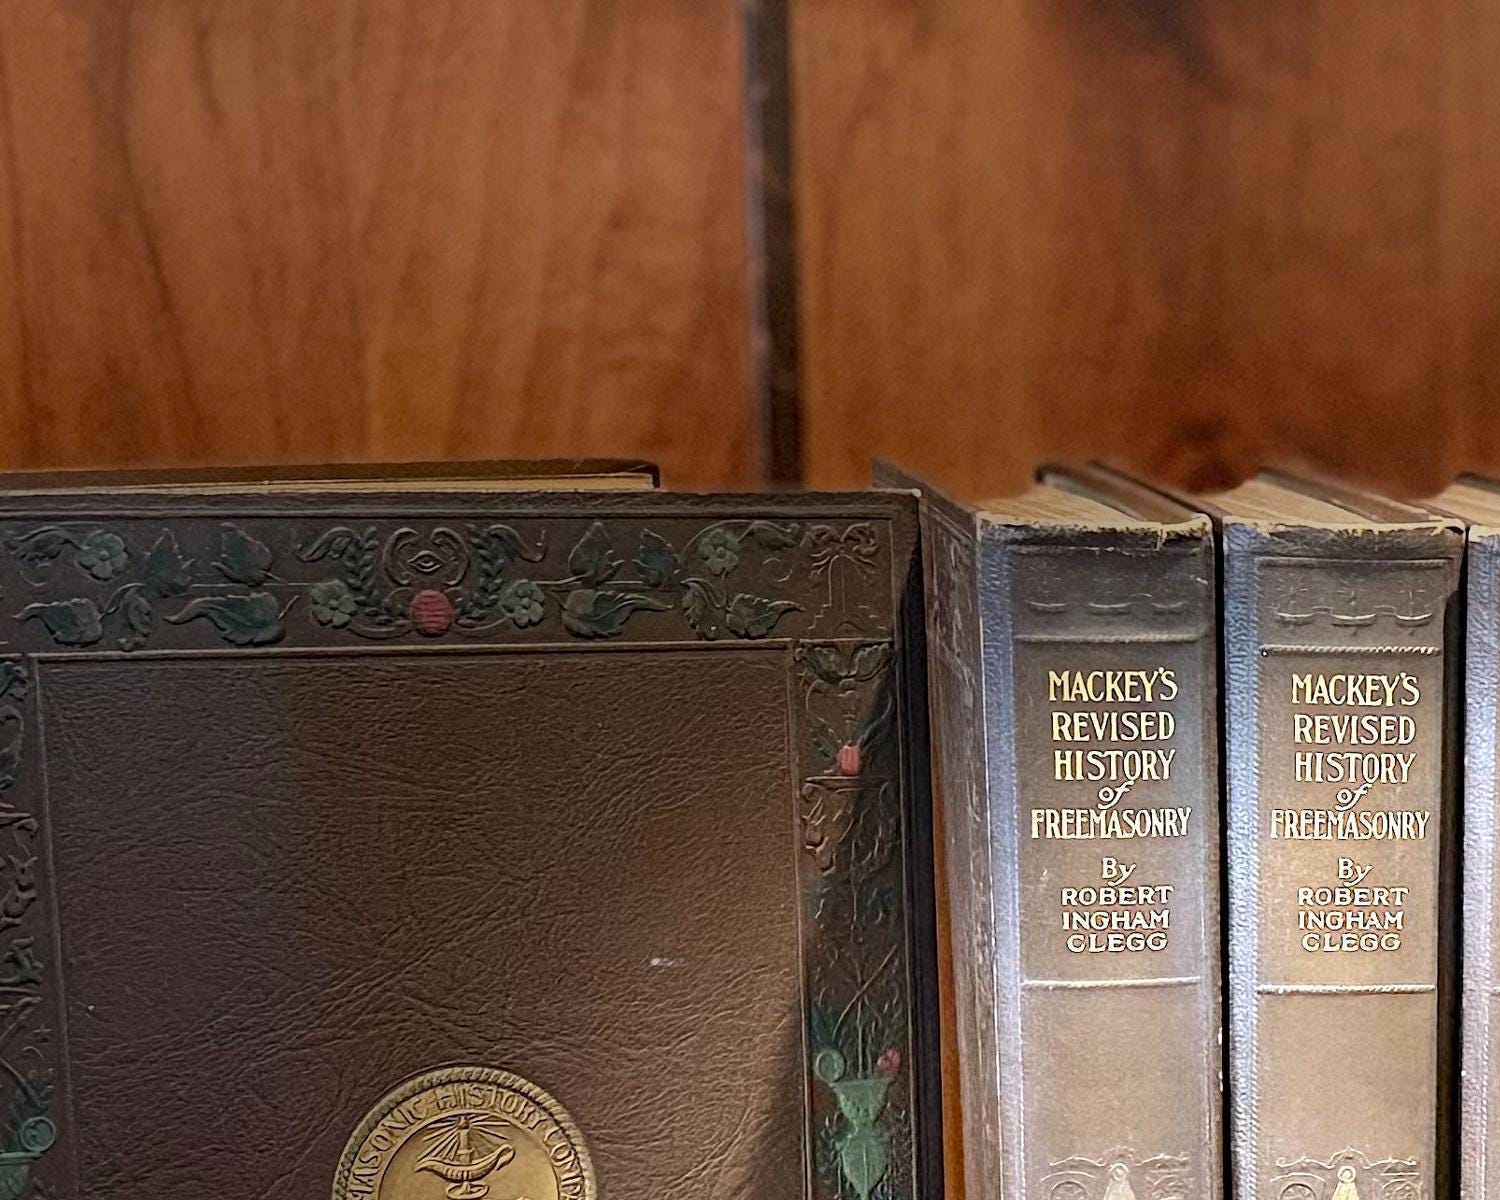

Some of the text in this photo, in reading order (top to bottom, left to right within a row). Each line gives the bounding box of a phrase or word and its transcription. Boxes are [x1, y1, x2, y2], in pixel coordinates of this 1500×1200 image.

[1048, 667, 1178, 703] MACKEY'S
[1290, 672, 1421, 706] MACKEY'S
[1051, 712, 1176, 742] REVISED
[1294, 715, 1416, 745] REVISED
[1055, 749, 1176, 782] HISTORY
[1295, 752, 1416, 784] HISTORY
[1097, 780, 1134, 810] of
[1335, 782, 1373, 811] of
[1031, 806, 1192, 839] FREEMASONRY
[1270, 808, 1430, 840] FREEMASONRY
[1101, 857, 1137, 887] By
[1338, 857, 1374, 887] By
[1061, 885, 1174, 906] ROBERT
[1298, 886, 1409, 906] ROBERT
[1062, 910, 1170, 930] INGHAM
[1298, 910, 1404, 930] INGHAM
[1066, 932, 1168, 953] CLEGG
[1301, 932, 1403, 952] CLEGG
[436, 1084, 546, 1130] HISTORY
